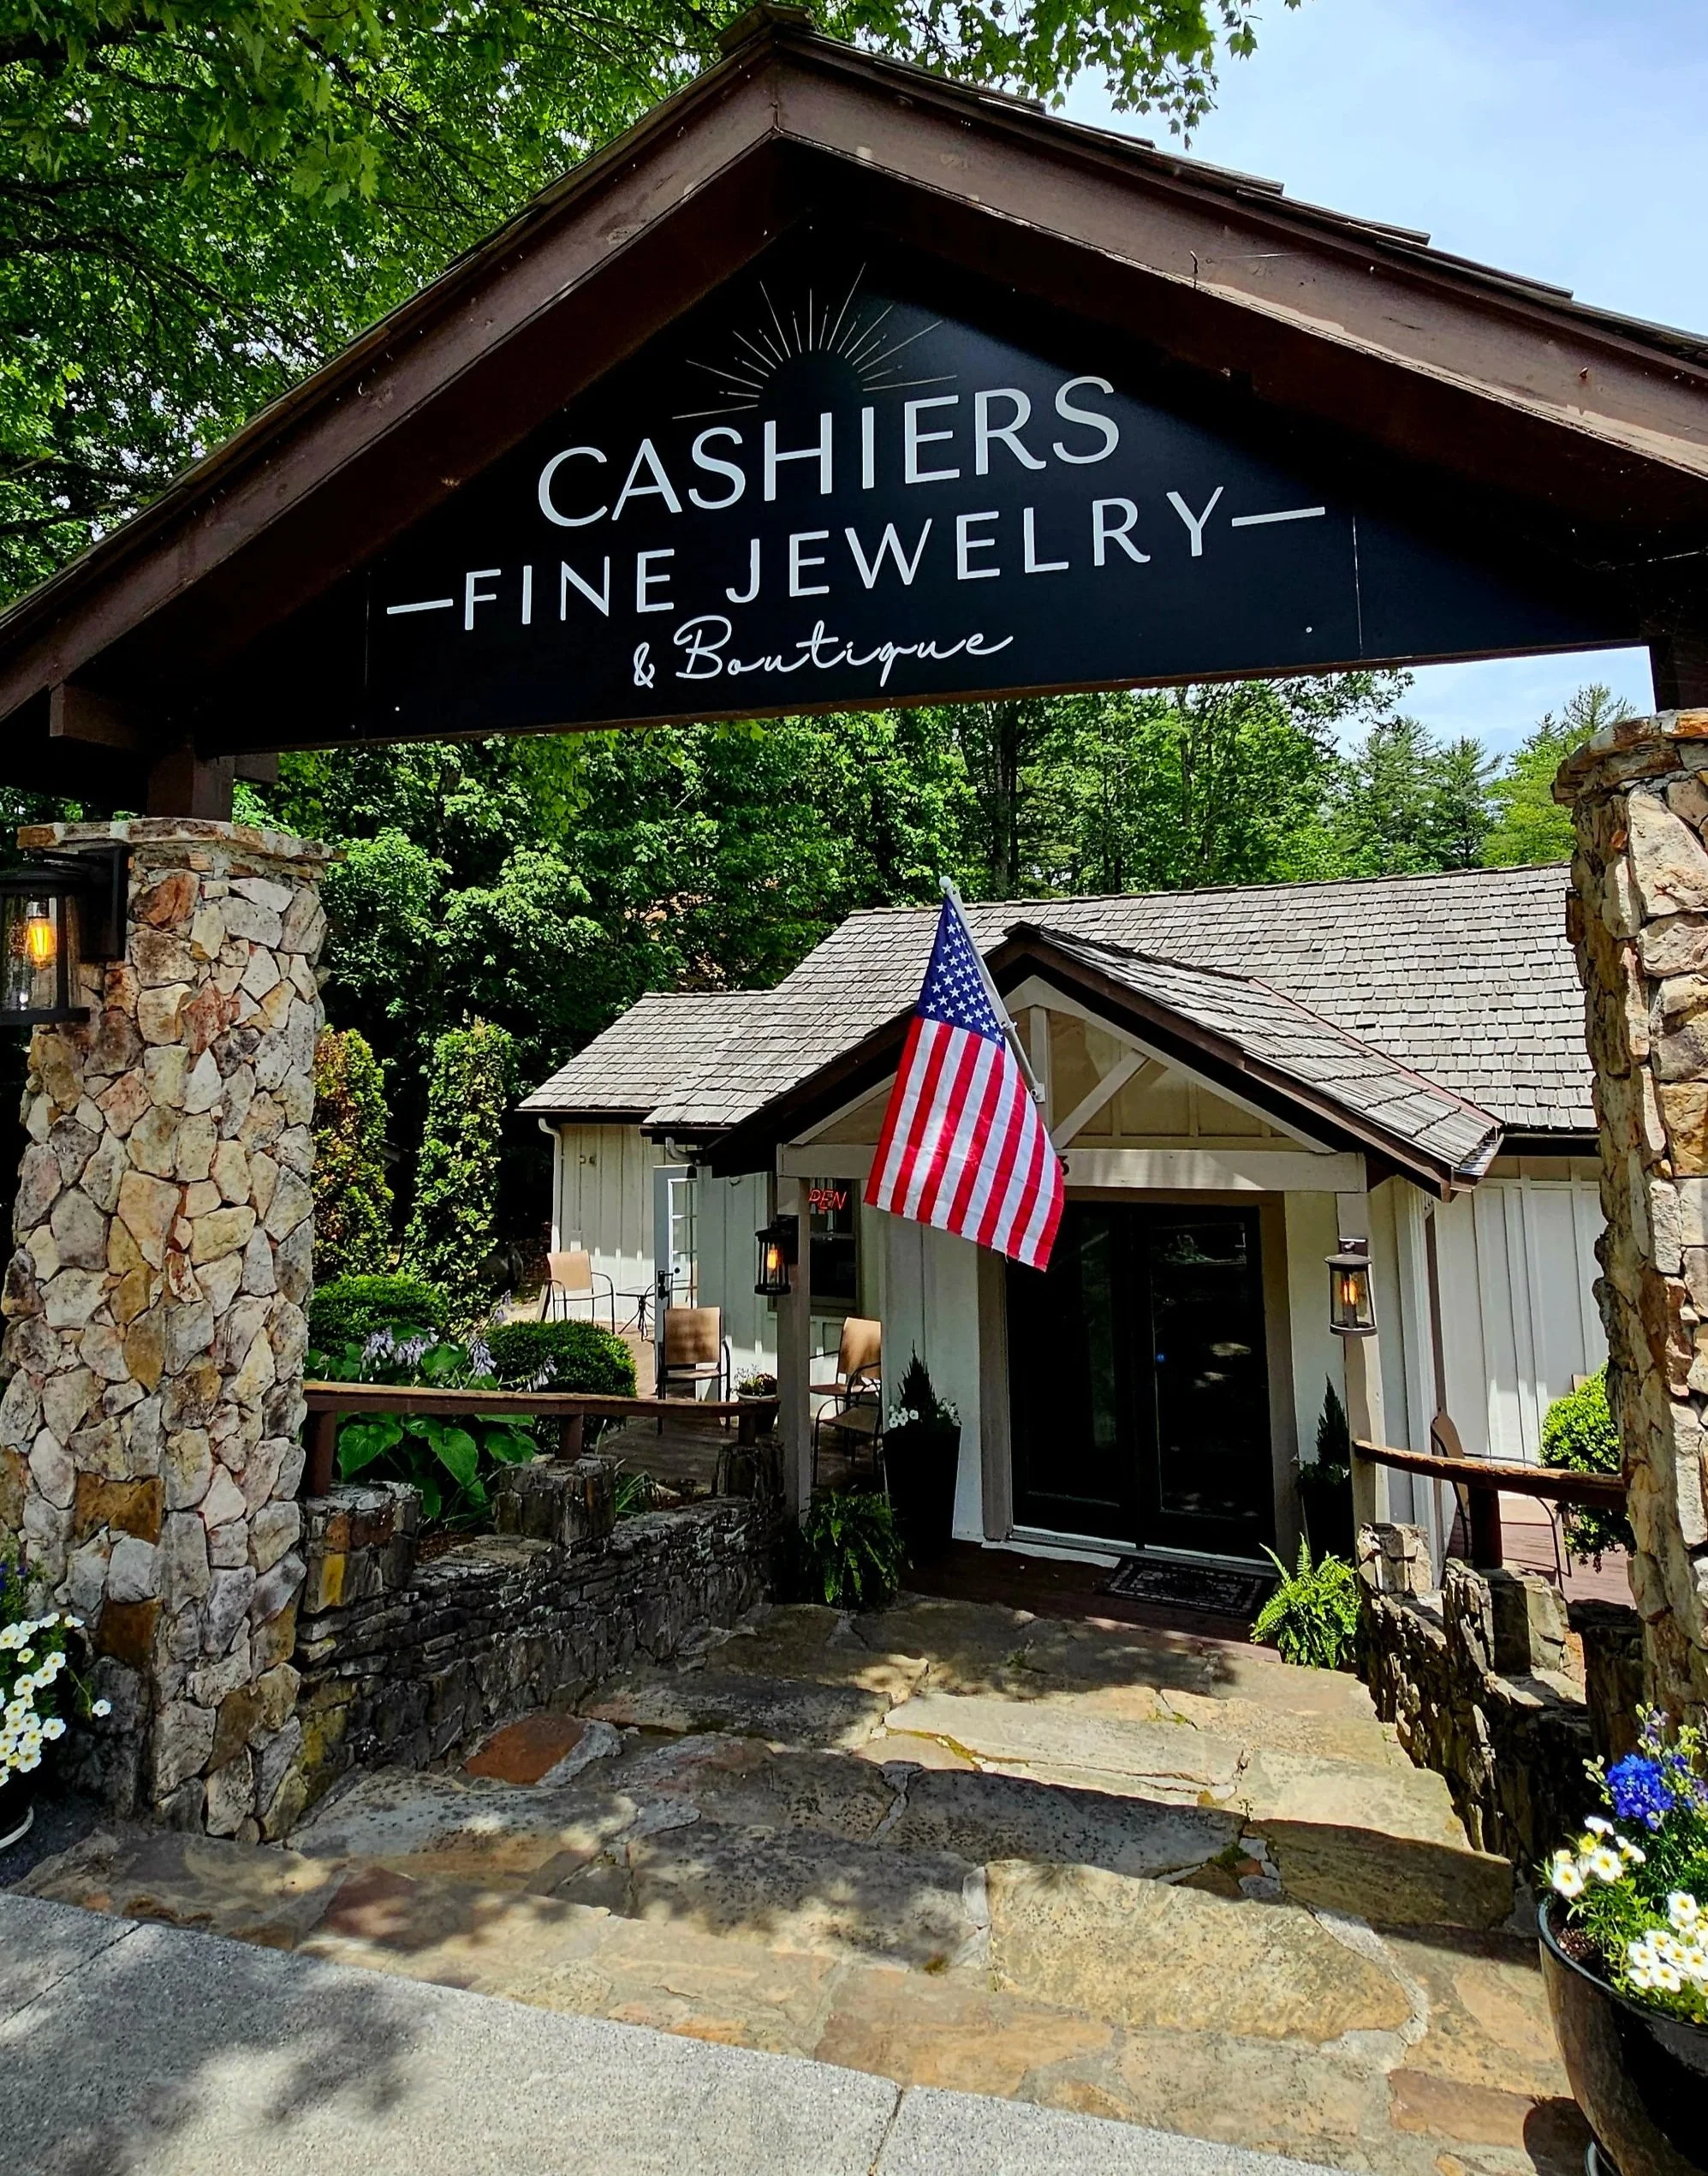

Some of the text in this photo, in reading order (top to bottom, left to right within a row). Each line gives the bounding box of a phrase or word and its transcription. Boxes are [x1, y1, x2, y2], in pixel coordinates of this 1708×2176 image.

[537, 376, 1121, 528] CASHIERS
[464, 486, 1224, 631] FINE JEWELRY
[633, 614, 1014, 689] & Boutique
